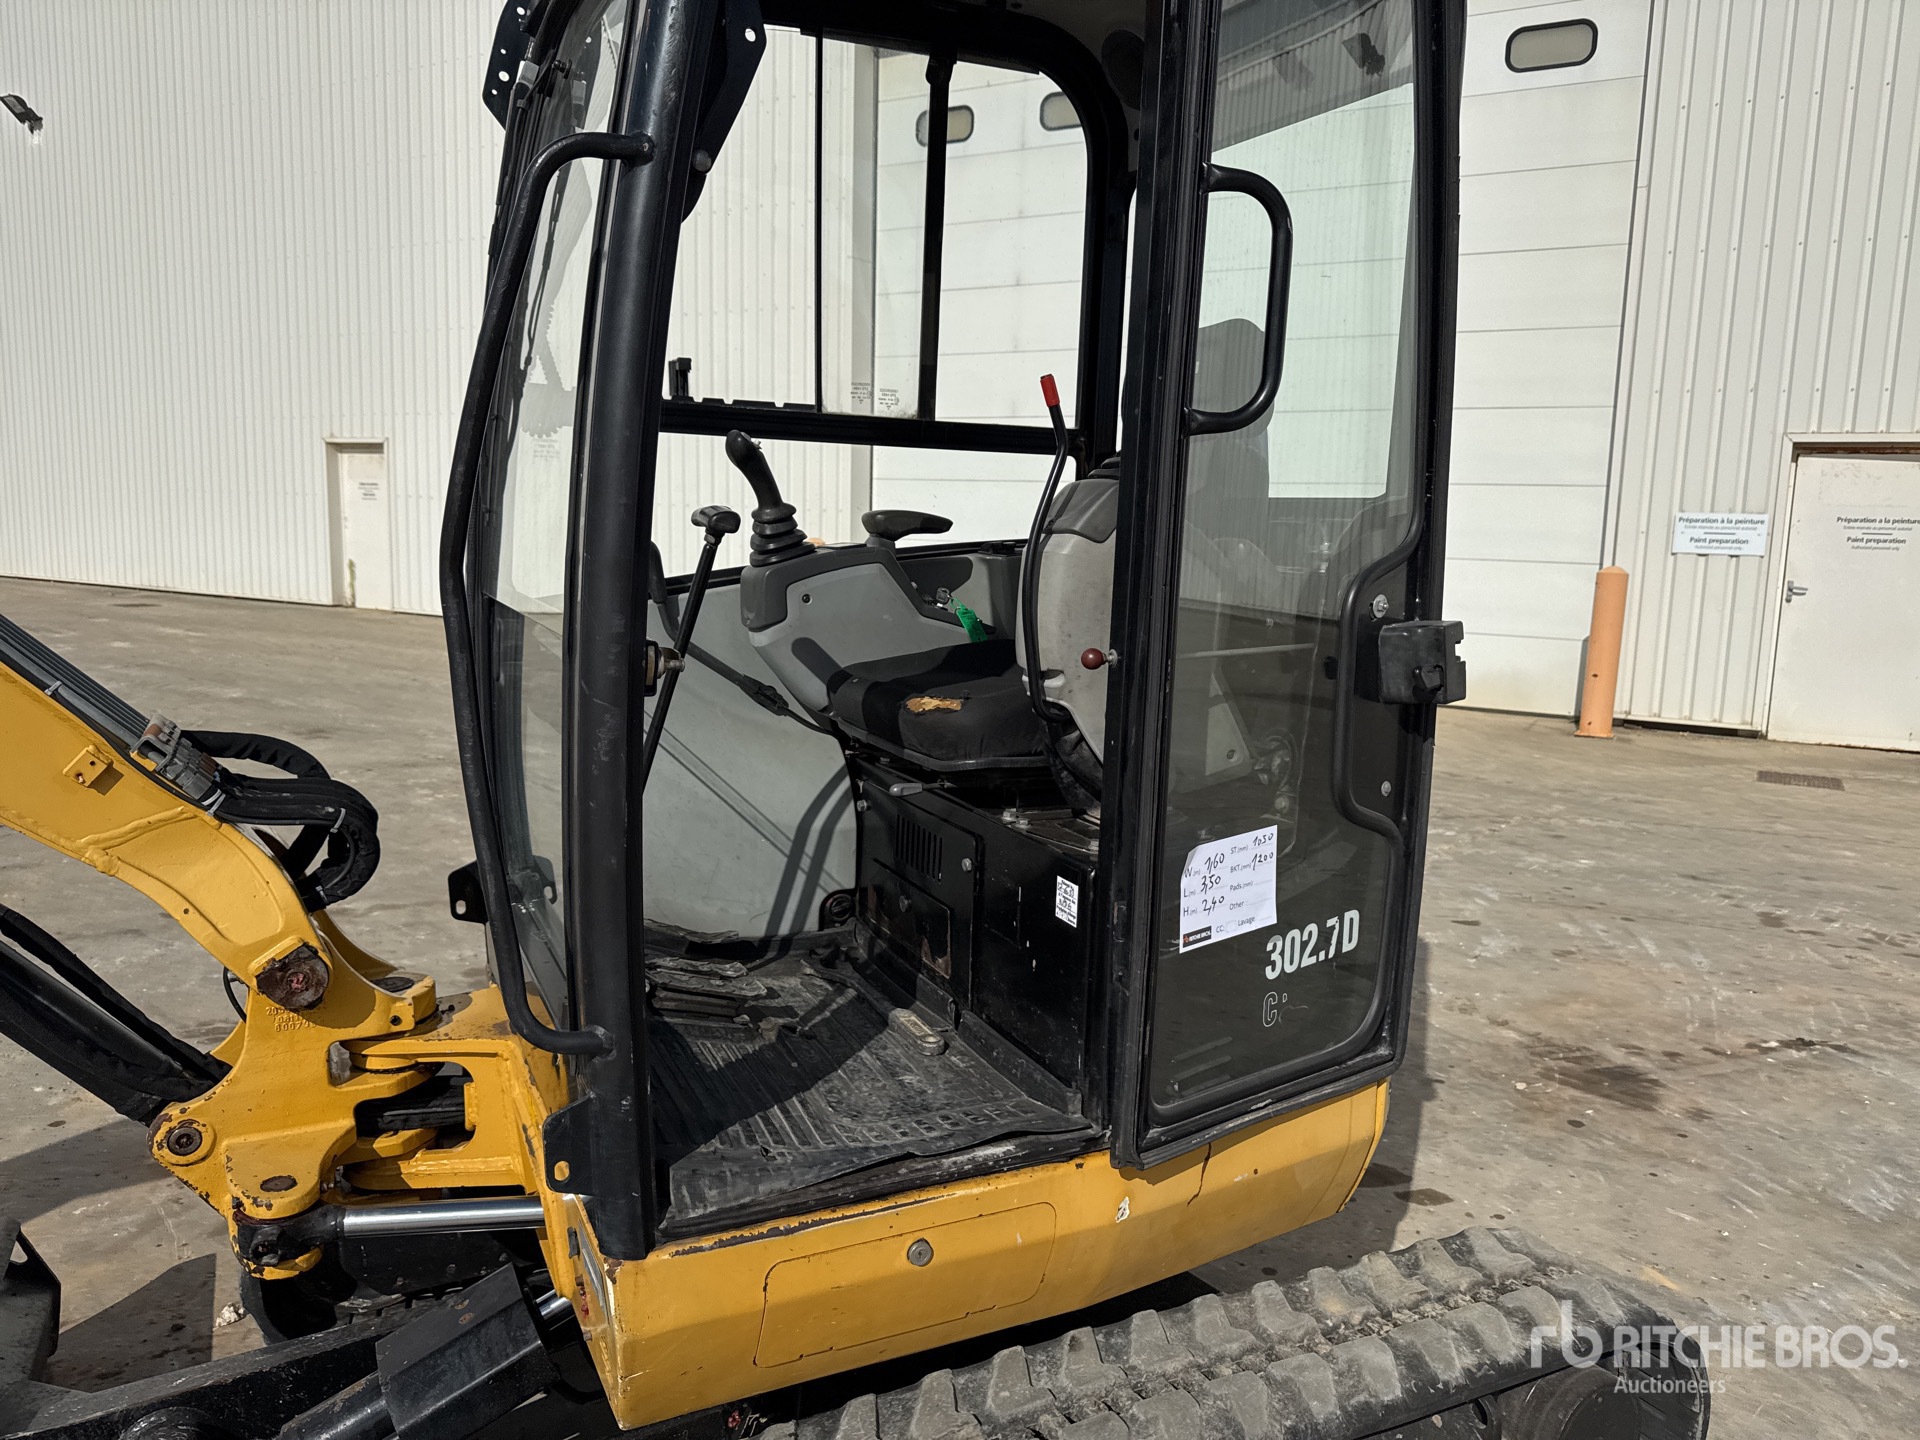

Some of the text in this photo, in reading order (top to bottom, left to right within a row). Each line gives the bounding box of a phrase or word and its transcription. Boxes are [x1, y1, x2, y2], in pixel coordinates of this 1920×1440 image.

[1678, 516, 1718, 524] Préparation
[1230, 846, 1237, 854] ST
[1230, 864, 1240, 873] BKT
[1252, 852, 1273, 871] 1200
[1184, 867, 1192, 878] W
[1230, 883, 1242, 891] Pads
[1183, 906, 1189, 917] H
[1202, 896, 1225, 915] 2,40
[1238, 916, 1255, 926] Lavage
[1265, 910, 1359, 980] 302.7D
